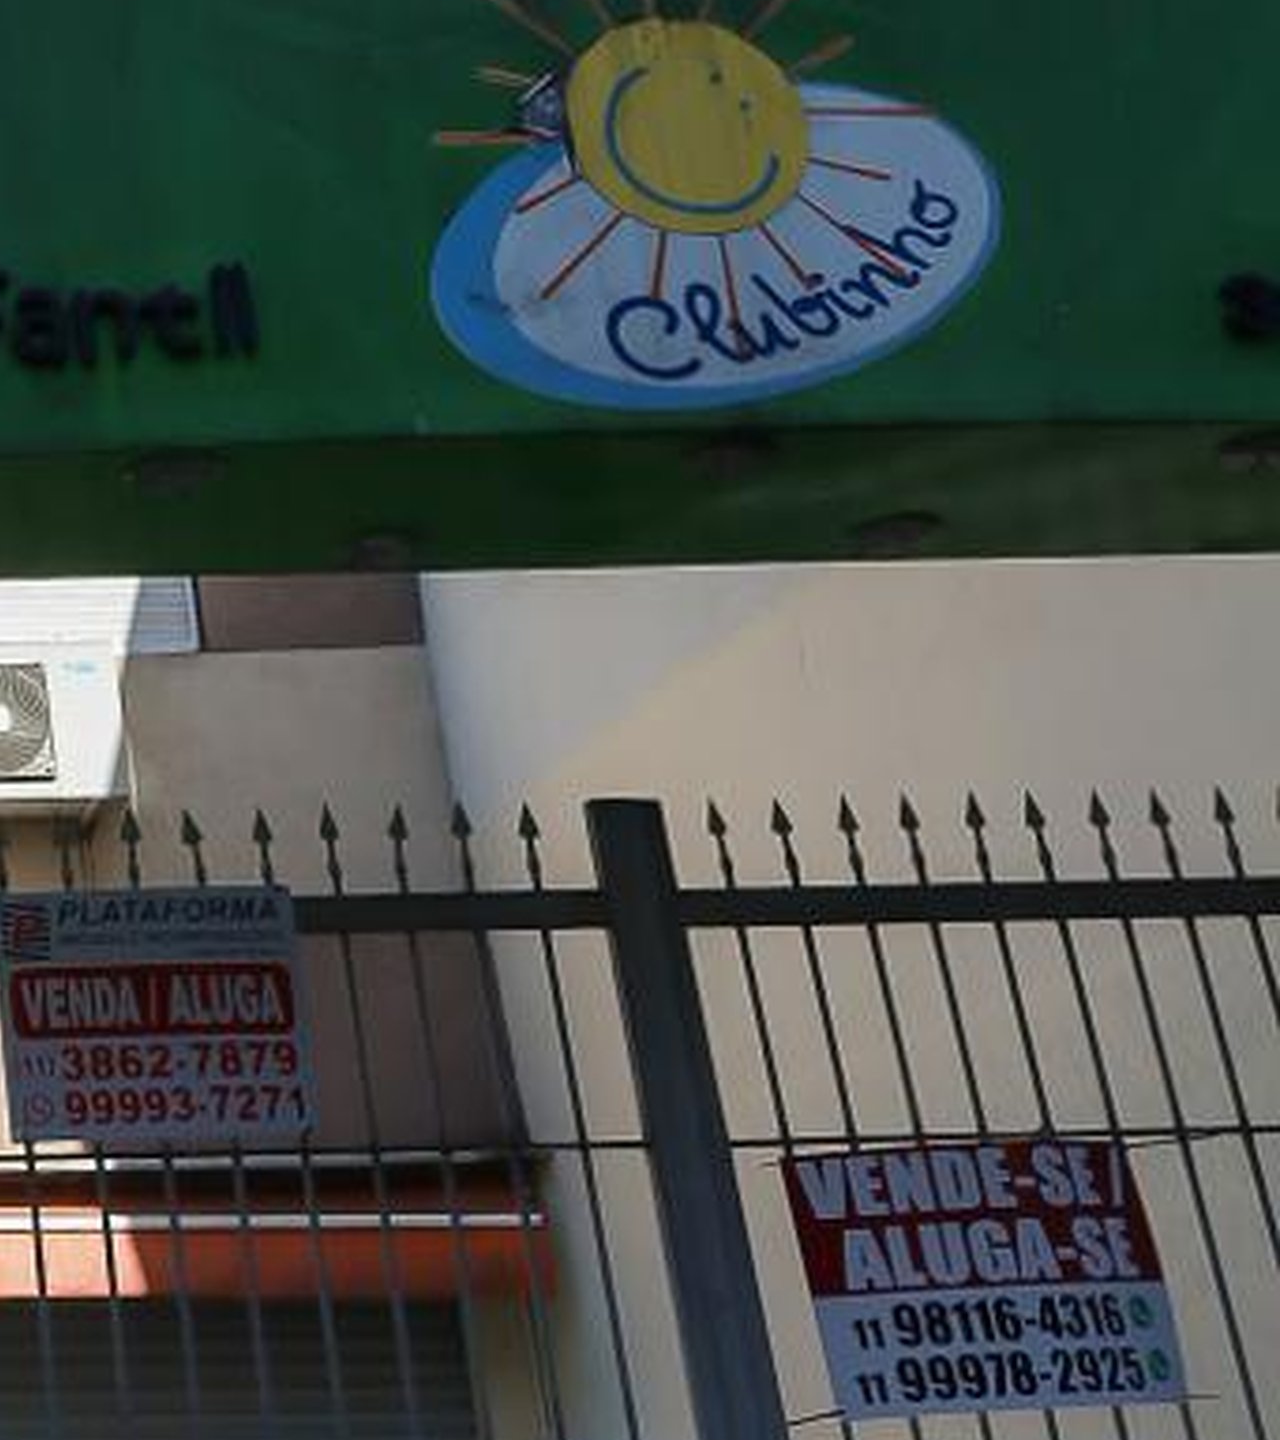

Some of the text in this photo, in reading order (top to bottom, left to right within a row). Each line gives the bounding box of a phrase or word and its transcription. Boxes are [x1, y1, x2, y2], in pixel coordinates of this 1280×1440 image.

[605, 178, 959, 380] Clubinho
[57, 895, 280, 926] PLATAFORMA
[20, 972, 286, 1030] VENDA ALUGA
[61, 1041, 298, 1082] 3862-7879
[65, 1085, 307, 1126] 99993-7271
[797, 1142, 1103, 1219] VENDE-SE
[843, 1216, 1141, 1291] ALUGA-SE
[853, 1292, 1127, 1350] 11 98116-4316
[856, 1347, 1146, 1405] 11 99978-2925
